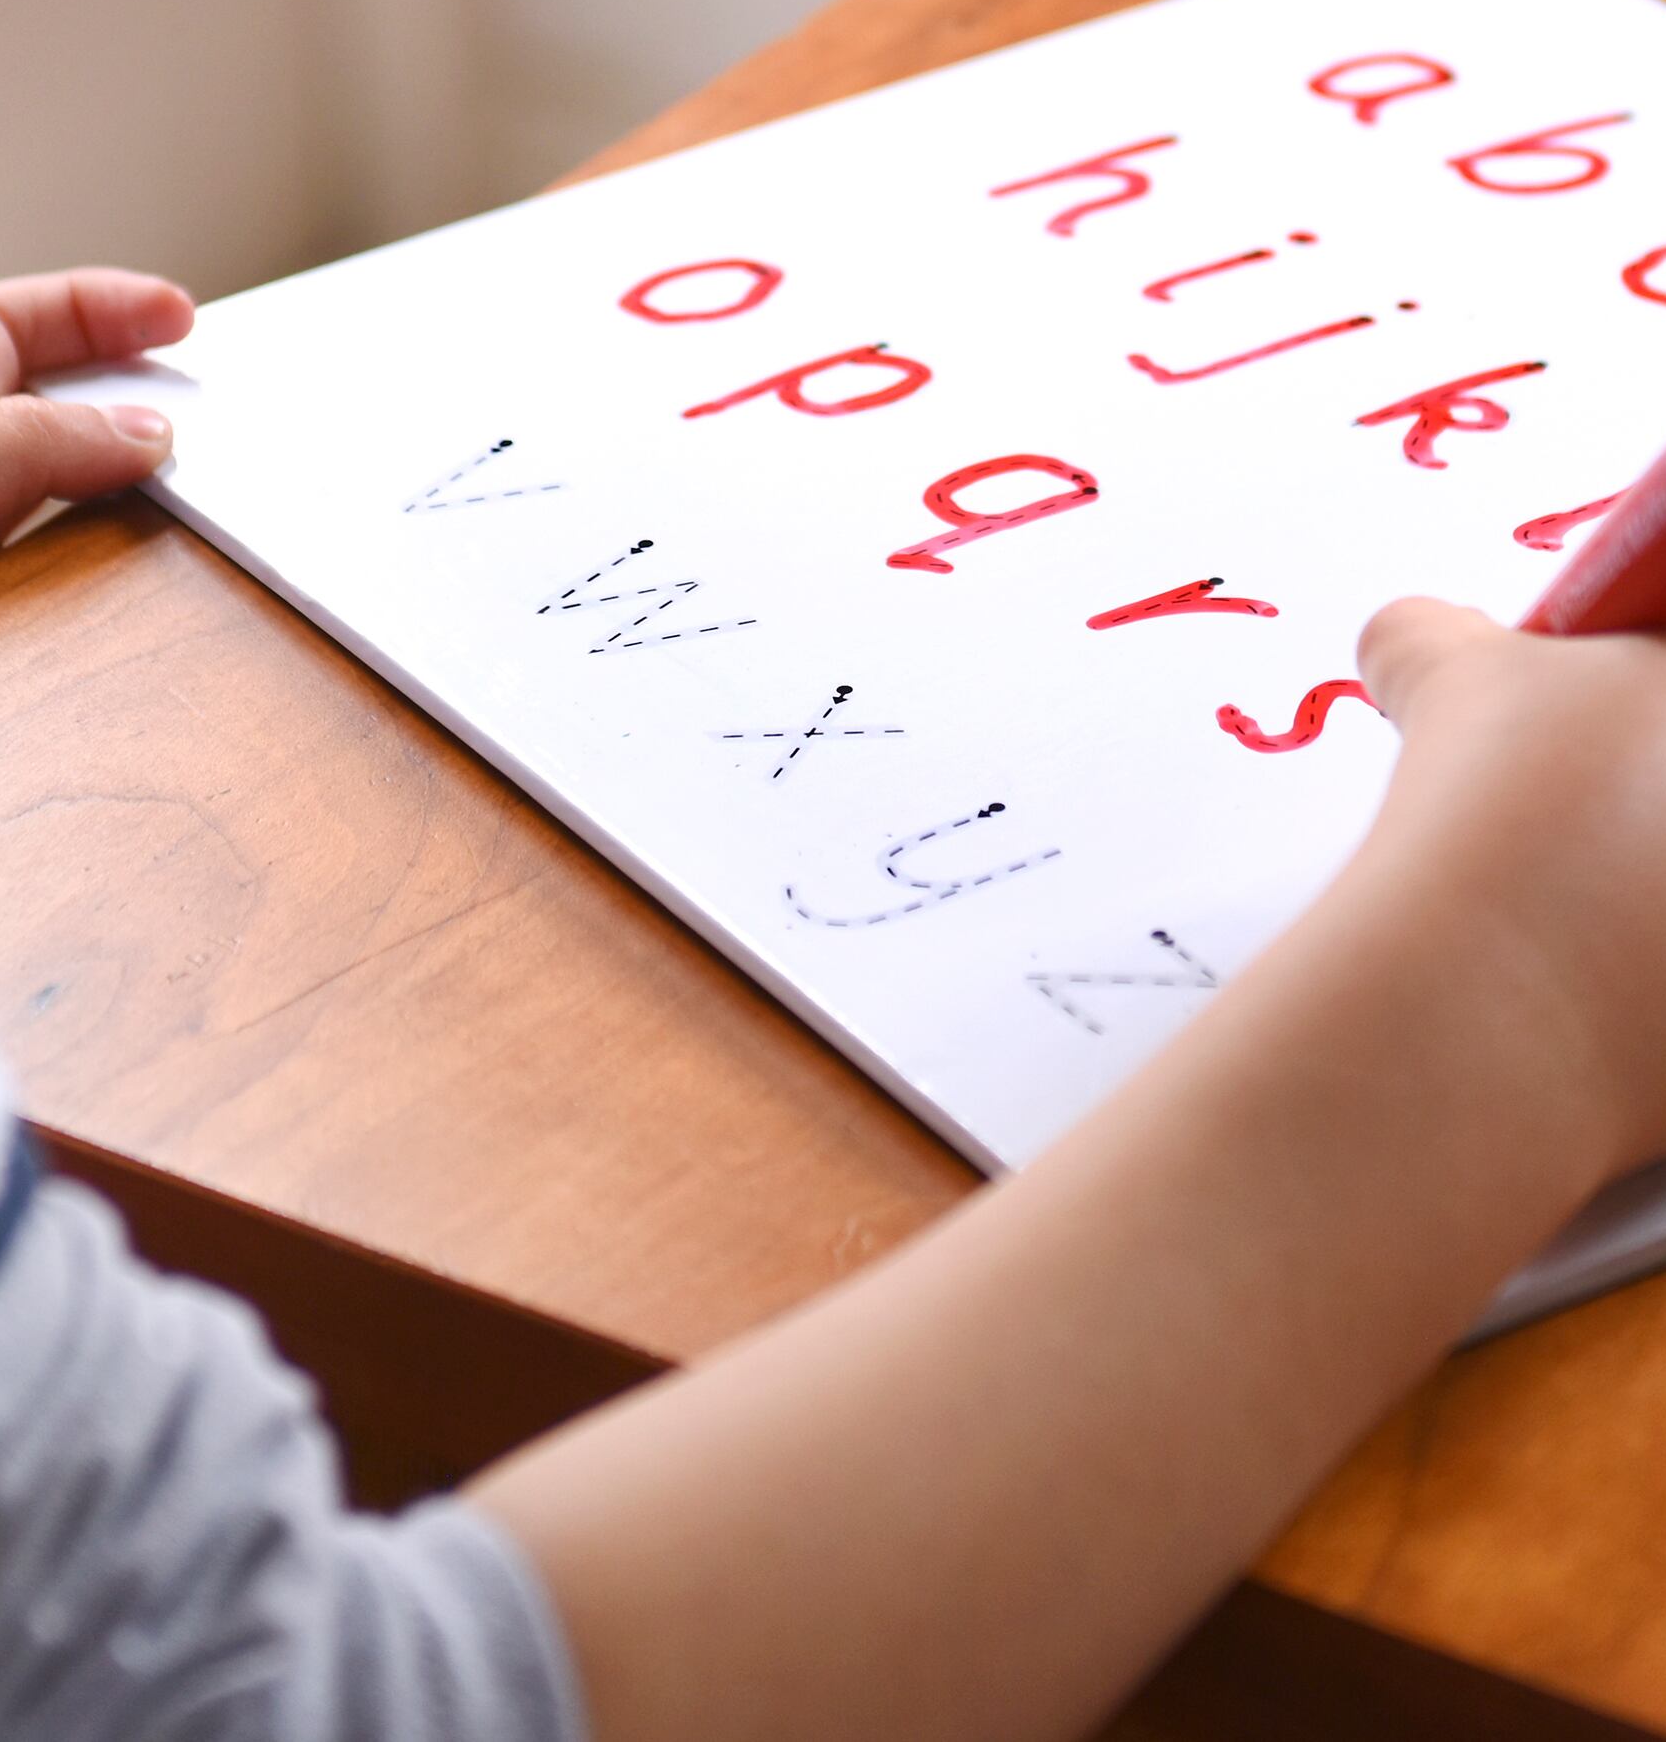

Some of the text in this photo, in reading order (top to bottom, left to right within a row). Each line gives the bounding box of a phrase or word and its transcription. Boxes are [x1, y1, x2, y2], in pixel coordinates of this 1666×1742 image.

[1307, 53, 1456, 126] a
[1447, 114, 1629, 196] b
[991, 136, 1177, 237] h
[1142, 231, 1318, 302] i
[1127, 298, 1419, 385] j
[1354, 361, 1547, 470] k
[618, 258, 1388, 754] o p q r s
[536, 539, 757, 654] w
[722, 685, 905, 779] x
[785, 802, 1061, 927] y
